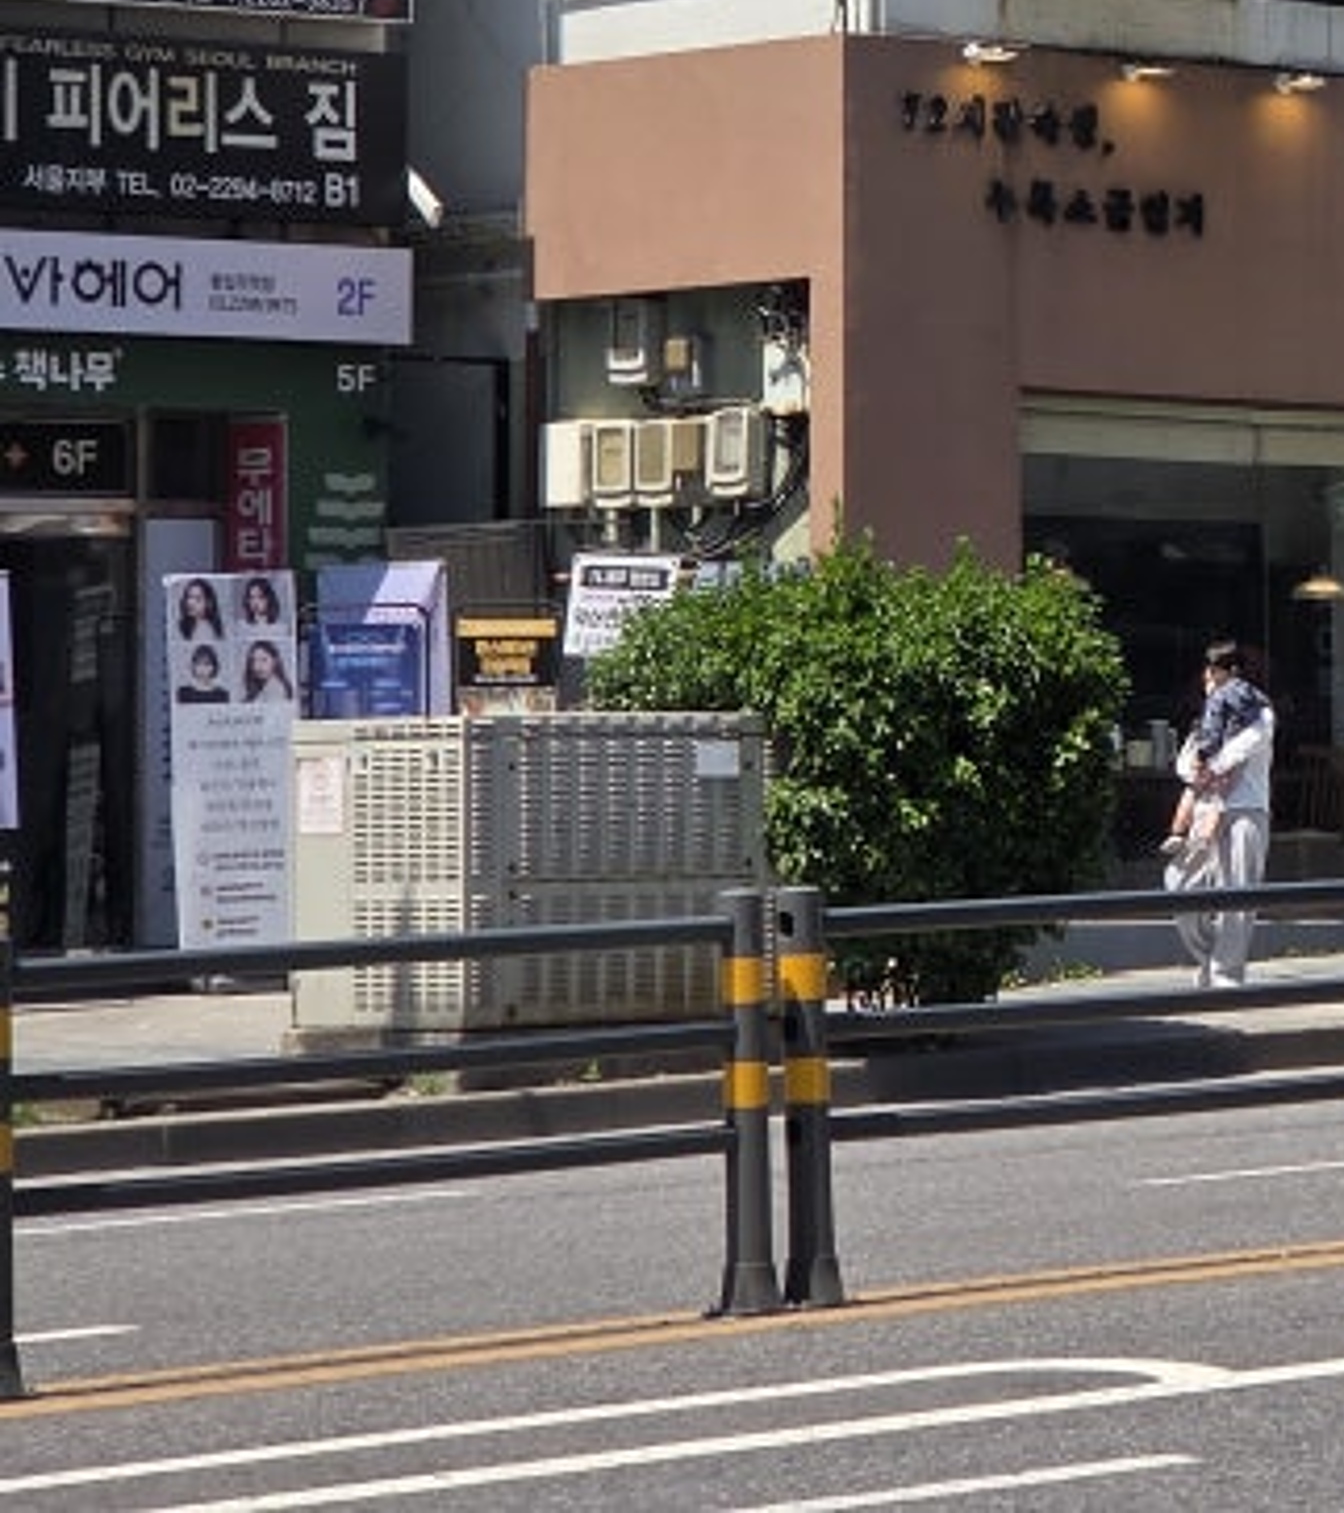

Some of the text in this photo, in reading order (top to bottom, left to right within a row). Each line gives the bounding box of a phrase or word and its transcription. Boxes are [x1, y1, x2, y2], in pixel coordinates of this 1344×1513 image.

[47, 63, 278, 155] 피어리스
[305, 81, 357, 162] 짐
[325, 174, 360, 208] B1
[336, 279, 376, 316] 2F
[337, 365, 376, 392] 5F
[52, 439, 98, 476] 6F
[236, 448, 273, 576] 무에타
